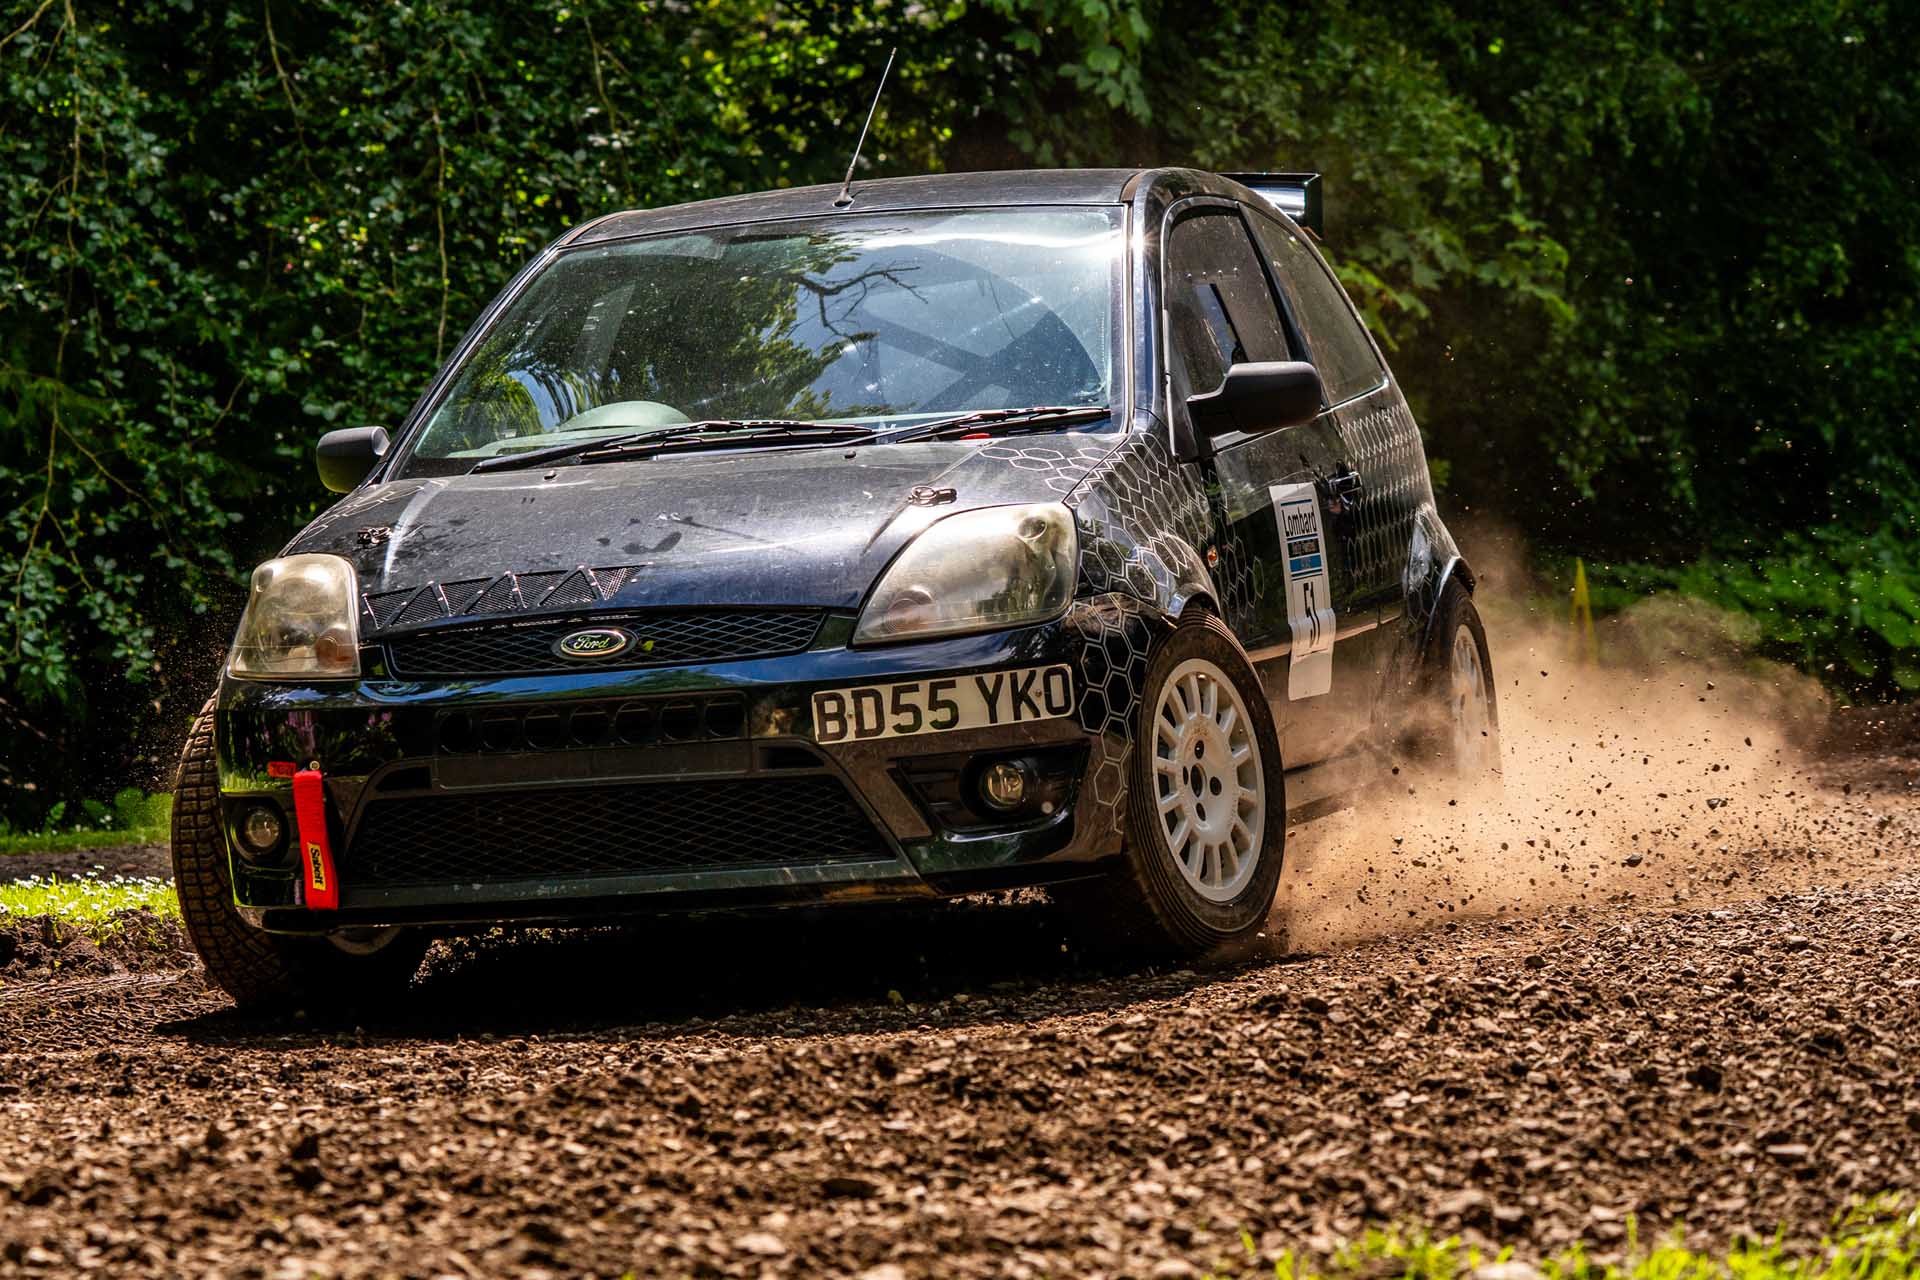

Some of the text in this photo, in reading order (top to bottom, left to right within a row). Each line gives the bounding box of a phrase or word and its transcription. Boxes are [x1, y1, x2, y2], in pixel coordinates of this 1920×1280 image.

[1281, 505, 1317, 537] Lombard
[1303, 581, 1320, 649] 51
[573, 634, 610, 650] Ford
[813, 665, 1074, 742] BD55 YKO
[310, 848, 323, 885] Sabelt
